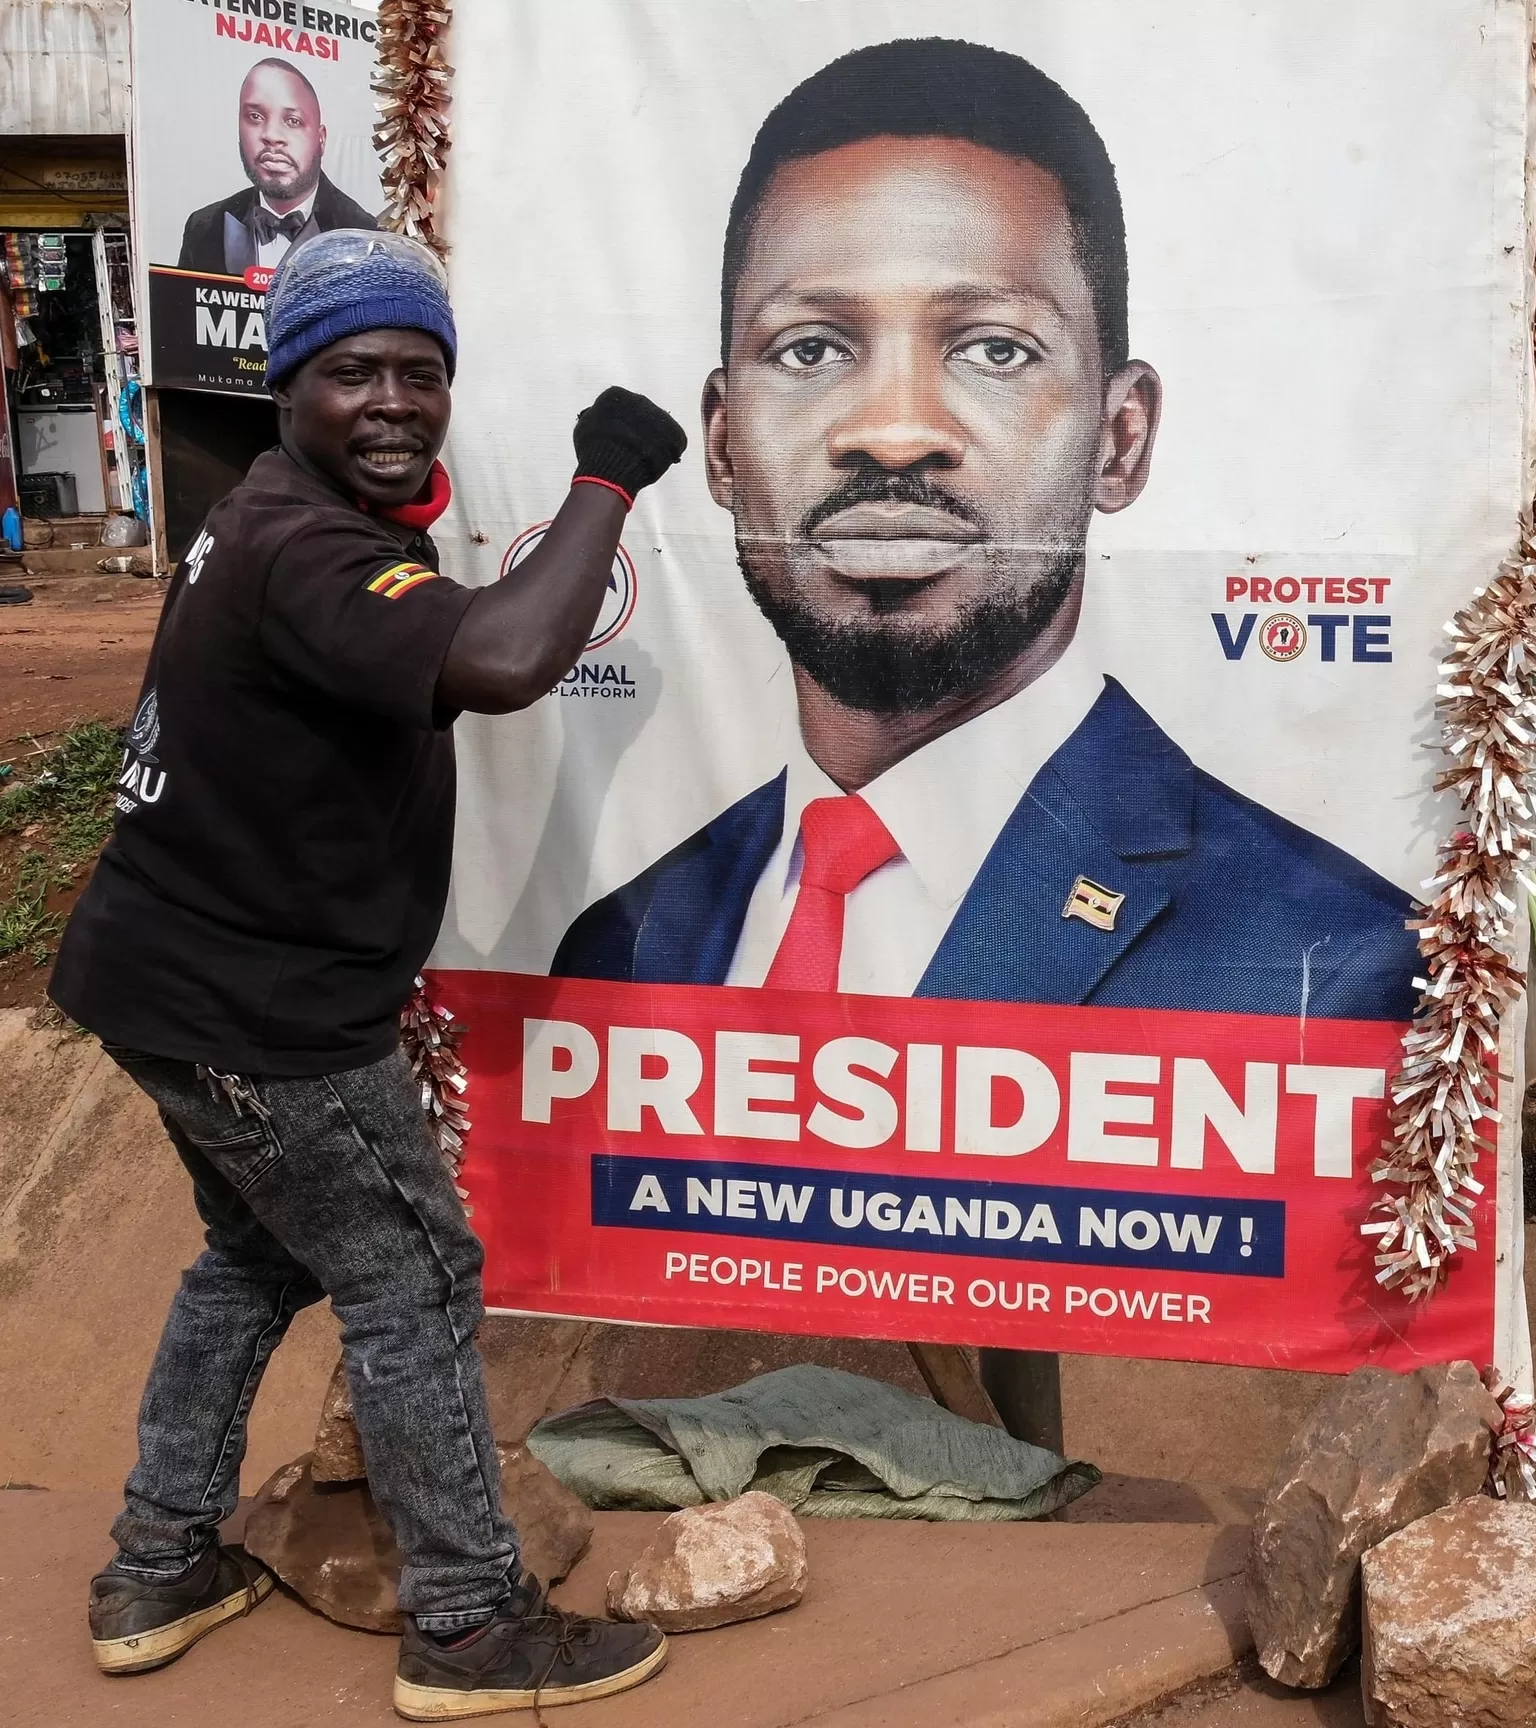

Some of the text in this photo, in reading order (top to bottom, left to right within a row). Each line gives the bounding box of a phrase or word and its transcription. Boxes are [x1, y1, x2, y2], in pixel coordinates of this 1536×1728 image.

[216, 13, 339, 61] NJAKASI
[198, 374, 253, 386] Mukama
[1226, 576, 1391, 604] PROTEST
[1210, 612, 1393, 663] VOTE
[549, 686, 636, 699] PLATFORM
[521, 1018, 1386, 1179] PRESIDENT
[628, 1174, 671, 1213] A
[686, 1177, 815, 1223] NEW
[829, 1187, 1062, 1245] UGANDA
[1078, 1206, 1222, 1255] NOW
[665, 1251, 1211, 1324] PEOPLE POWER OUR POWER
